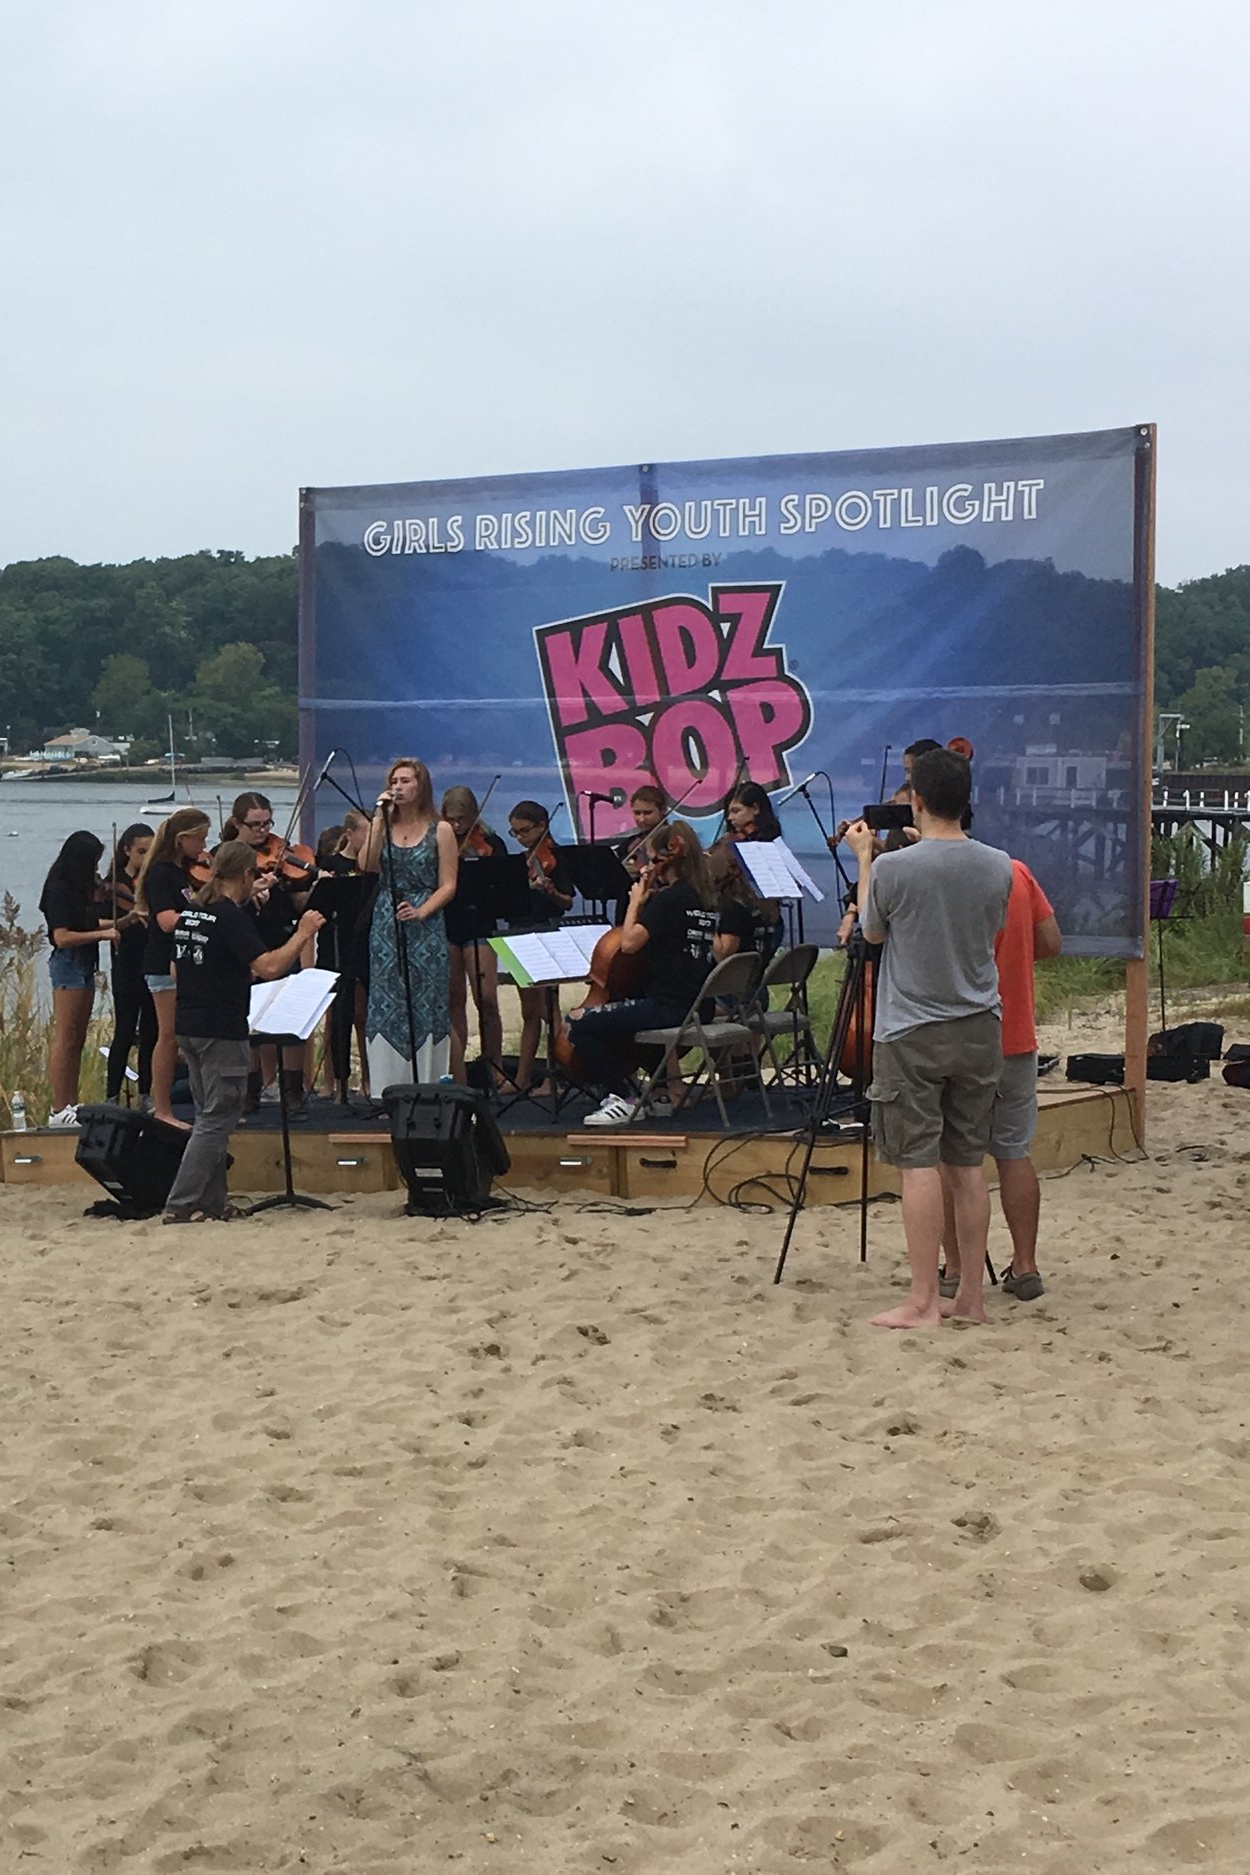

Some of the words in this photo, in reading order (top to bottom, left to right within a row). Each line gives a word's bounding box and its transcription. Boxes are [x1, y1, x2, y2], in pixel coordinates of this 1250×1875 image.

[363, 514, 465, 557] GIRLS
[474, 505, 611, 551] RISING
[622, 497, 767, 542] YOUTH
[779, 478, 1045, 534] SPOTLIGHT
[610, 553, 699, 571] PRESENTED
[701, 552, 723, 567] BY
[544, 591, 778, 727] KIDZ
[563, 680, 804, 844] BOP
